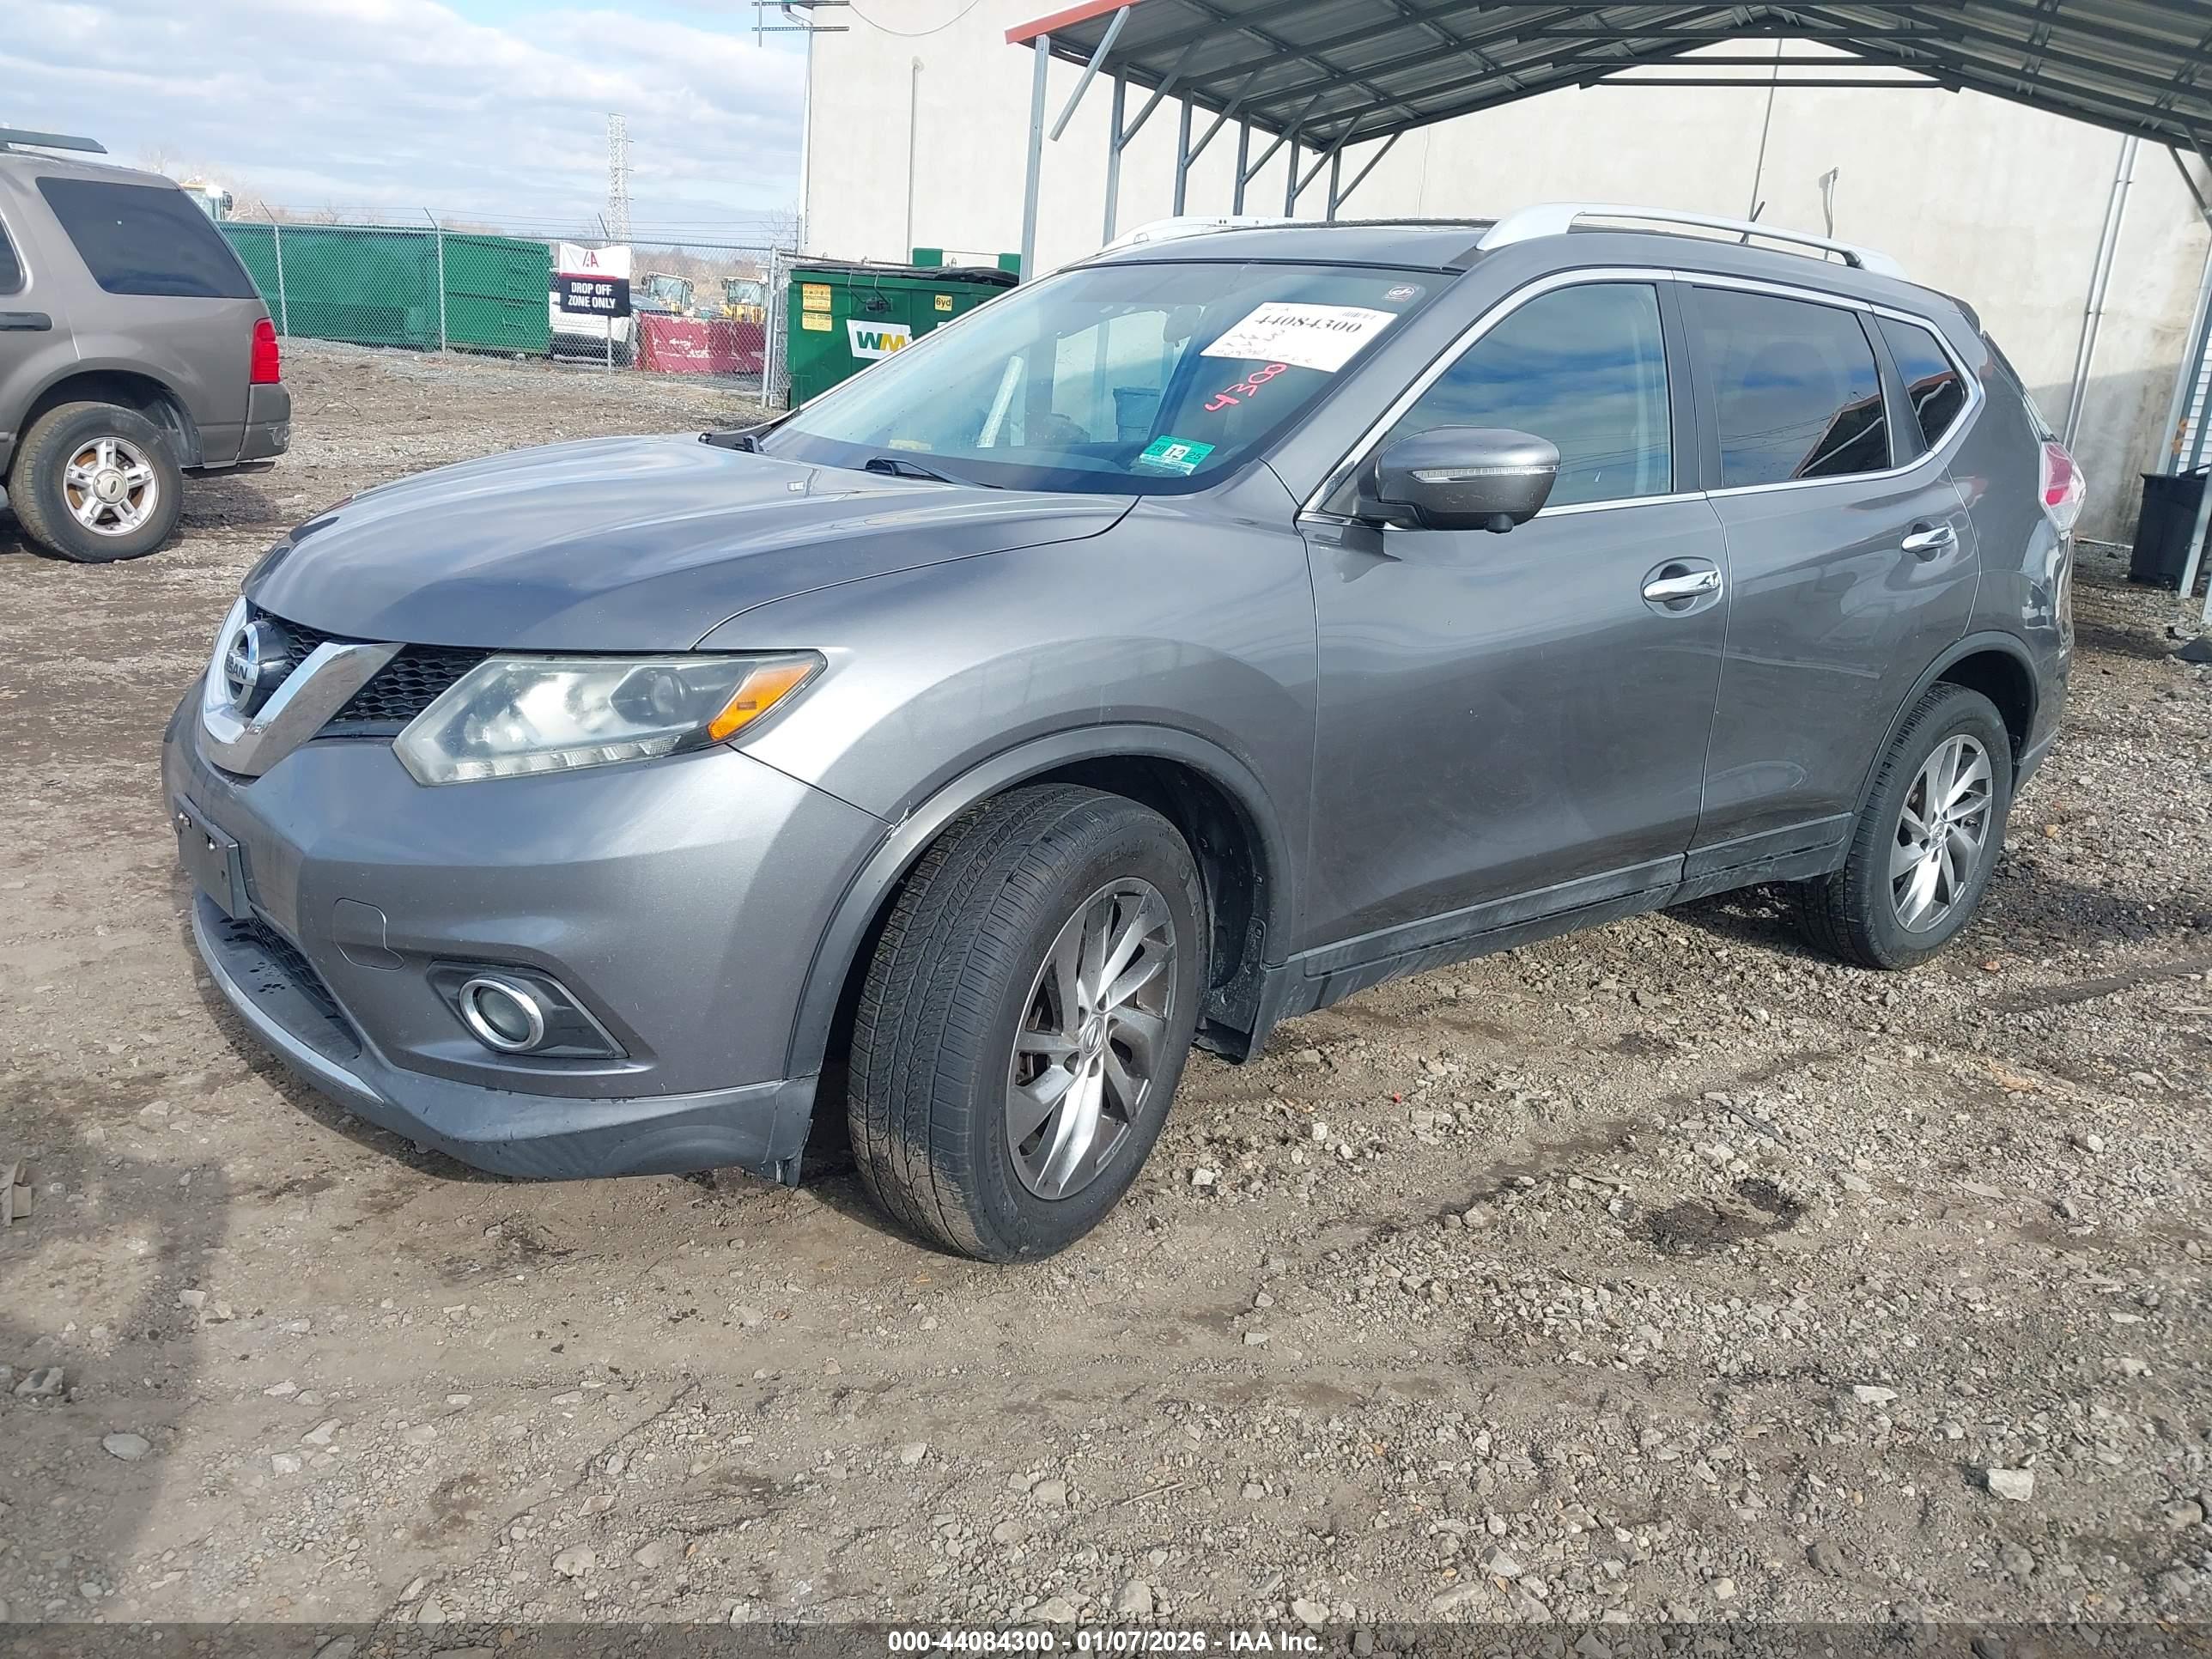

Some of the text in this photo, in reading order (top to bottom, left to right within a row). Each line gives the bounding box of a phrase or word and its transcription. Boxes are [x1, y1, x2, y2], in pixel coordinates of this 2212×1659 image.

[571, 282, 612, 295] DROP OFF
[568, 295, 617, 309] ZONE ONLY
[936, 296, 952, 307] 6yd
[1255, 314, 1363, 333] 44084300
[856, 331, 908, 351] WM
[1186, 452, 1201, 460] 25
